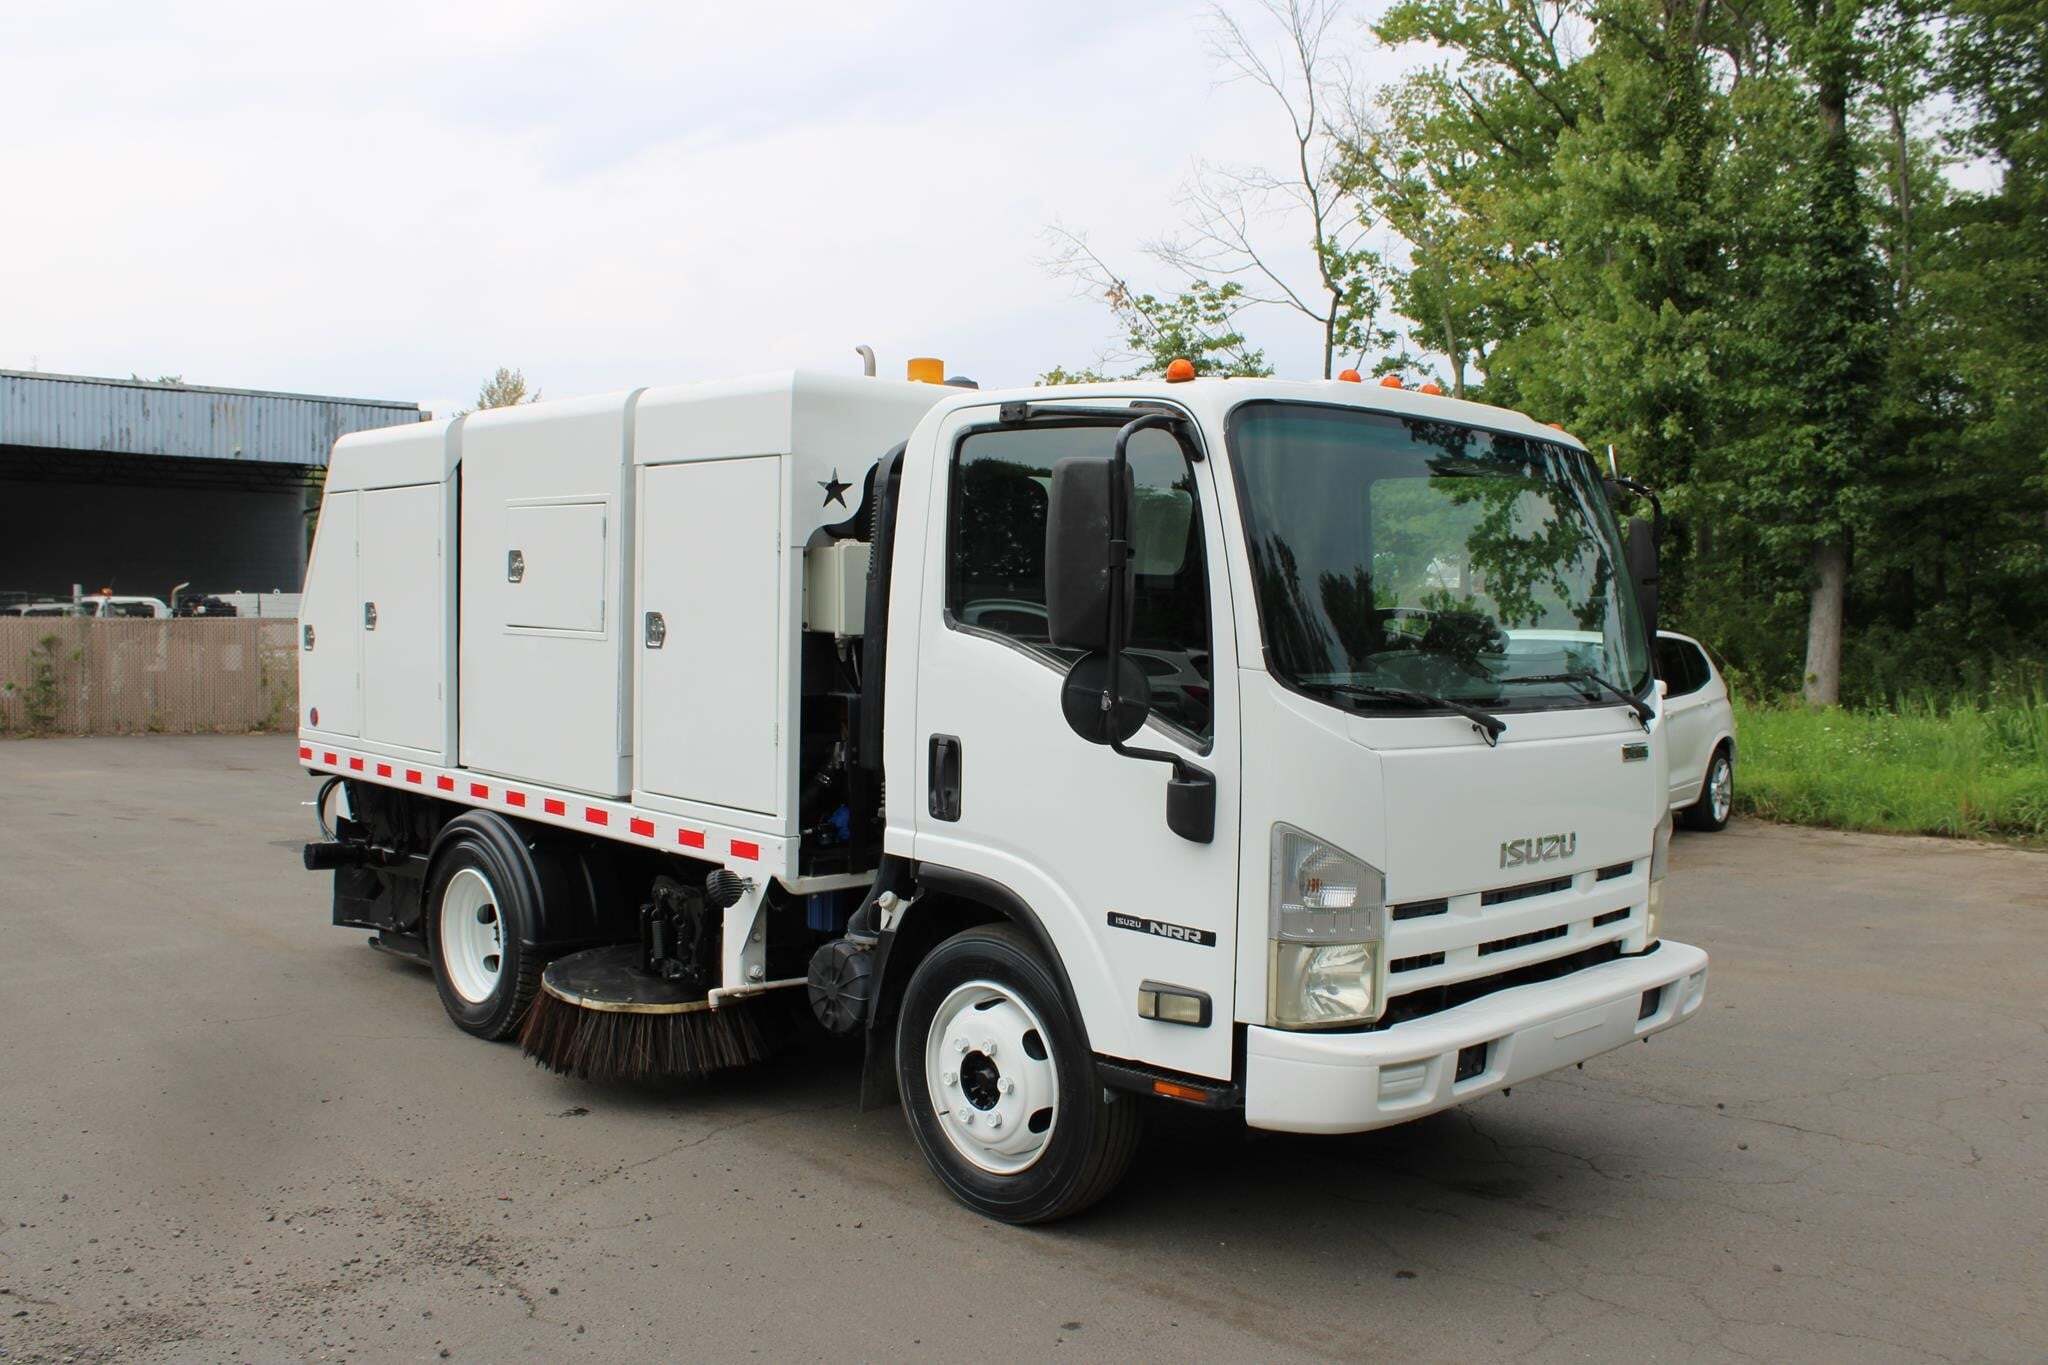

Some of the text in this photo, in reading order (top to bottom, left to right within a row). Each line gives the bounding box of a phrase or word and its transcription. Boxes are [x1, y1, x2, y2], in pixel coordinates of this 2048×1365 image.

[1500, 832, 1576, 869] ISUZU
[1115, 916, 1202, 943] ISUZU NRR
